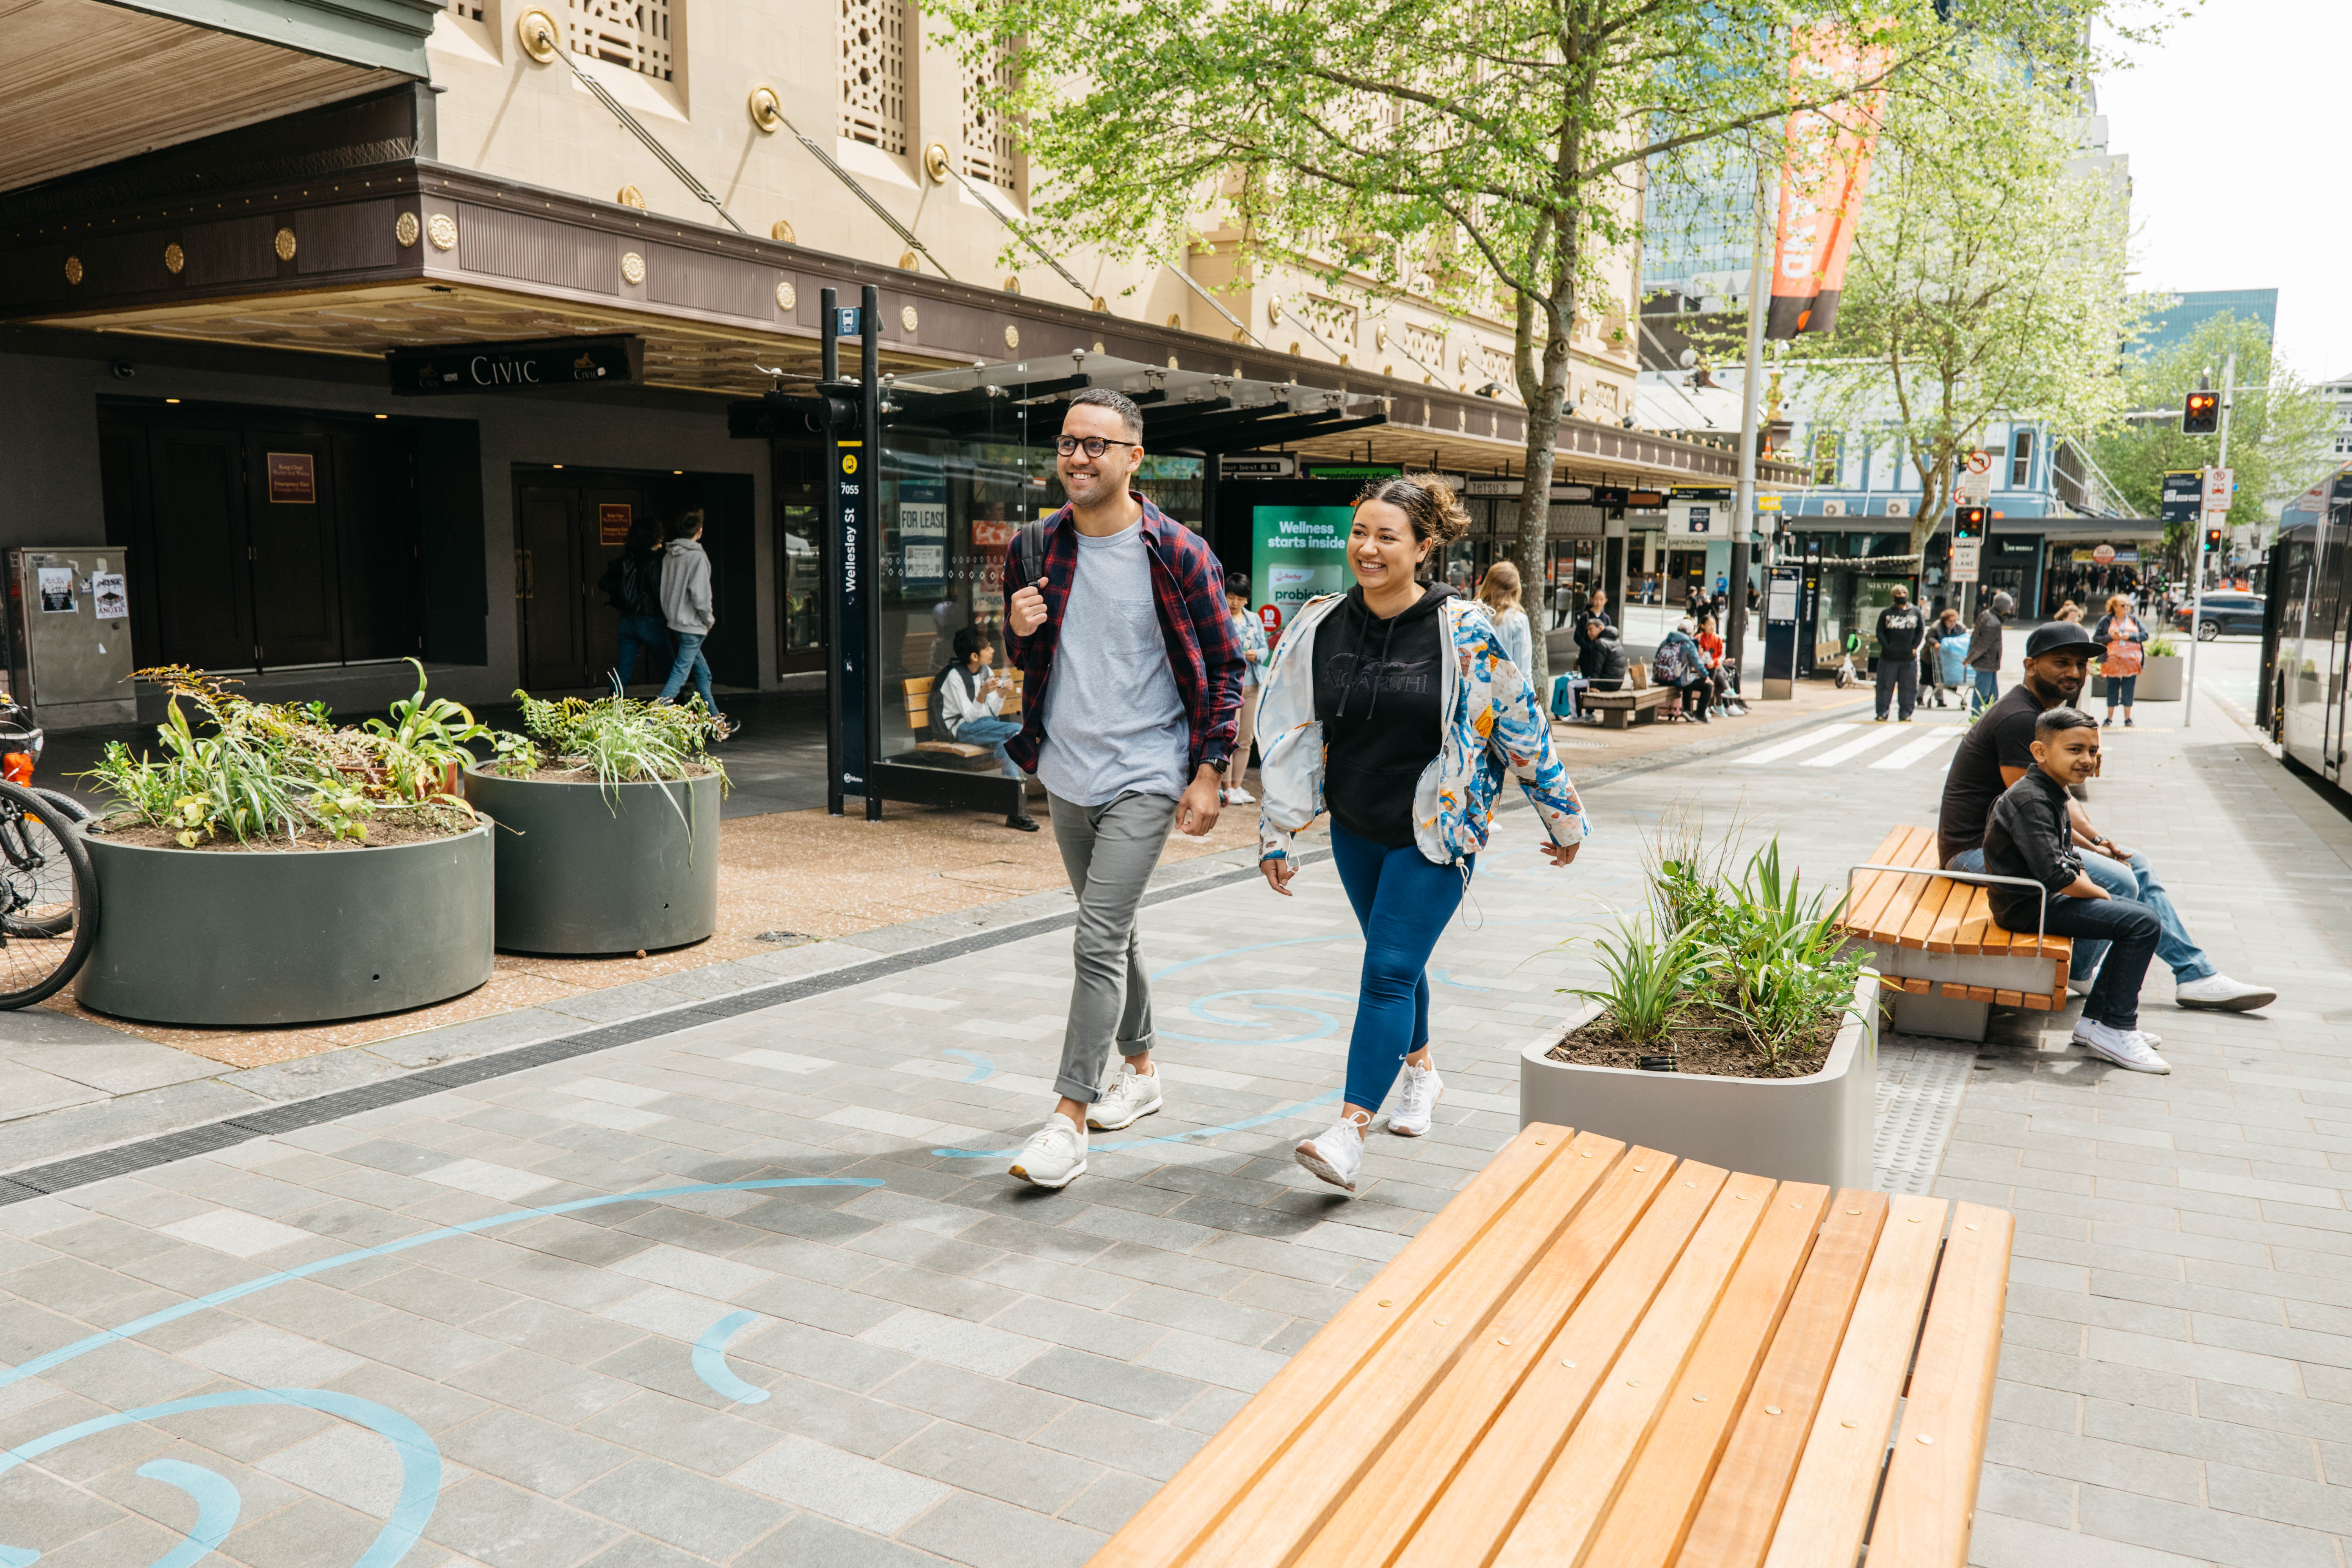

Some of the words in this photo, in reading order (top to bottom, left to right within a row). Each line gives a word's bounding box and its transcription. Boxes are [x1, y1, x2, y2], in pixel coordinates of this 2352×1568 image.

[471, 356, 539, 385] CIVIC
[841, 485, 859, 495] 7055
[844, 508, 855, 523] St
[902, 511, 917, 528] FOR
[1279, 521, 1334, 534] Wellness
[1268, 536, 1306, 548] starts
[1308, 535, 1346, 548] inside
[844, 526, 857, 593] Wellesley
[1264, 609, 1275, 621] 10
